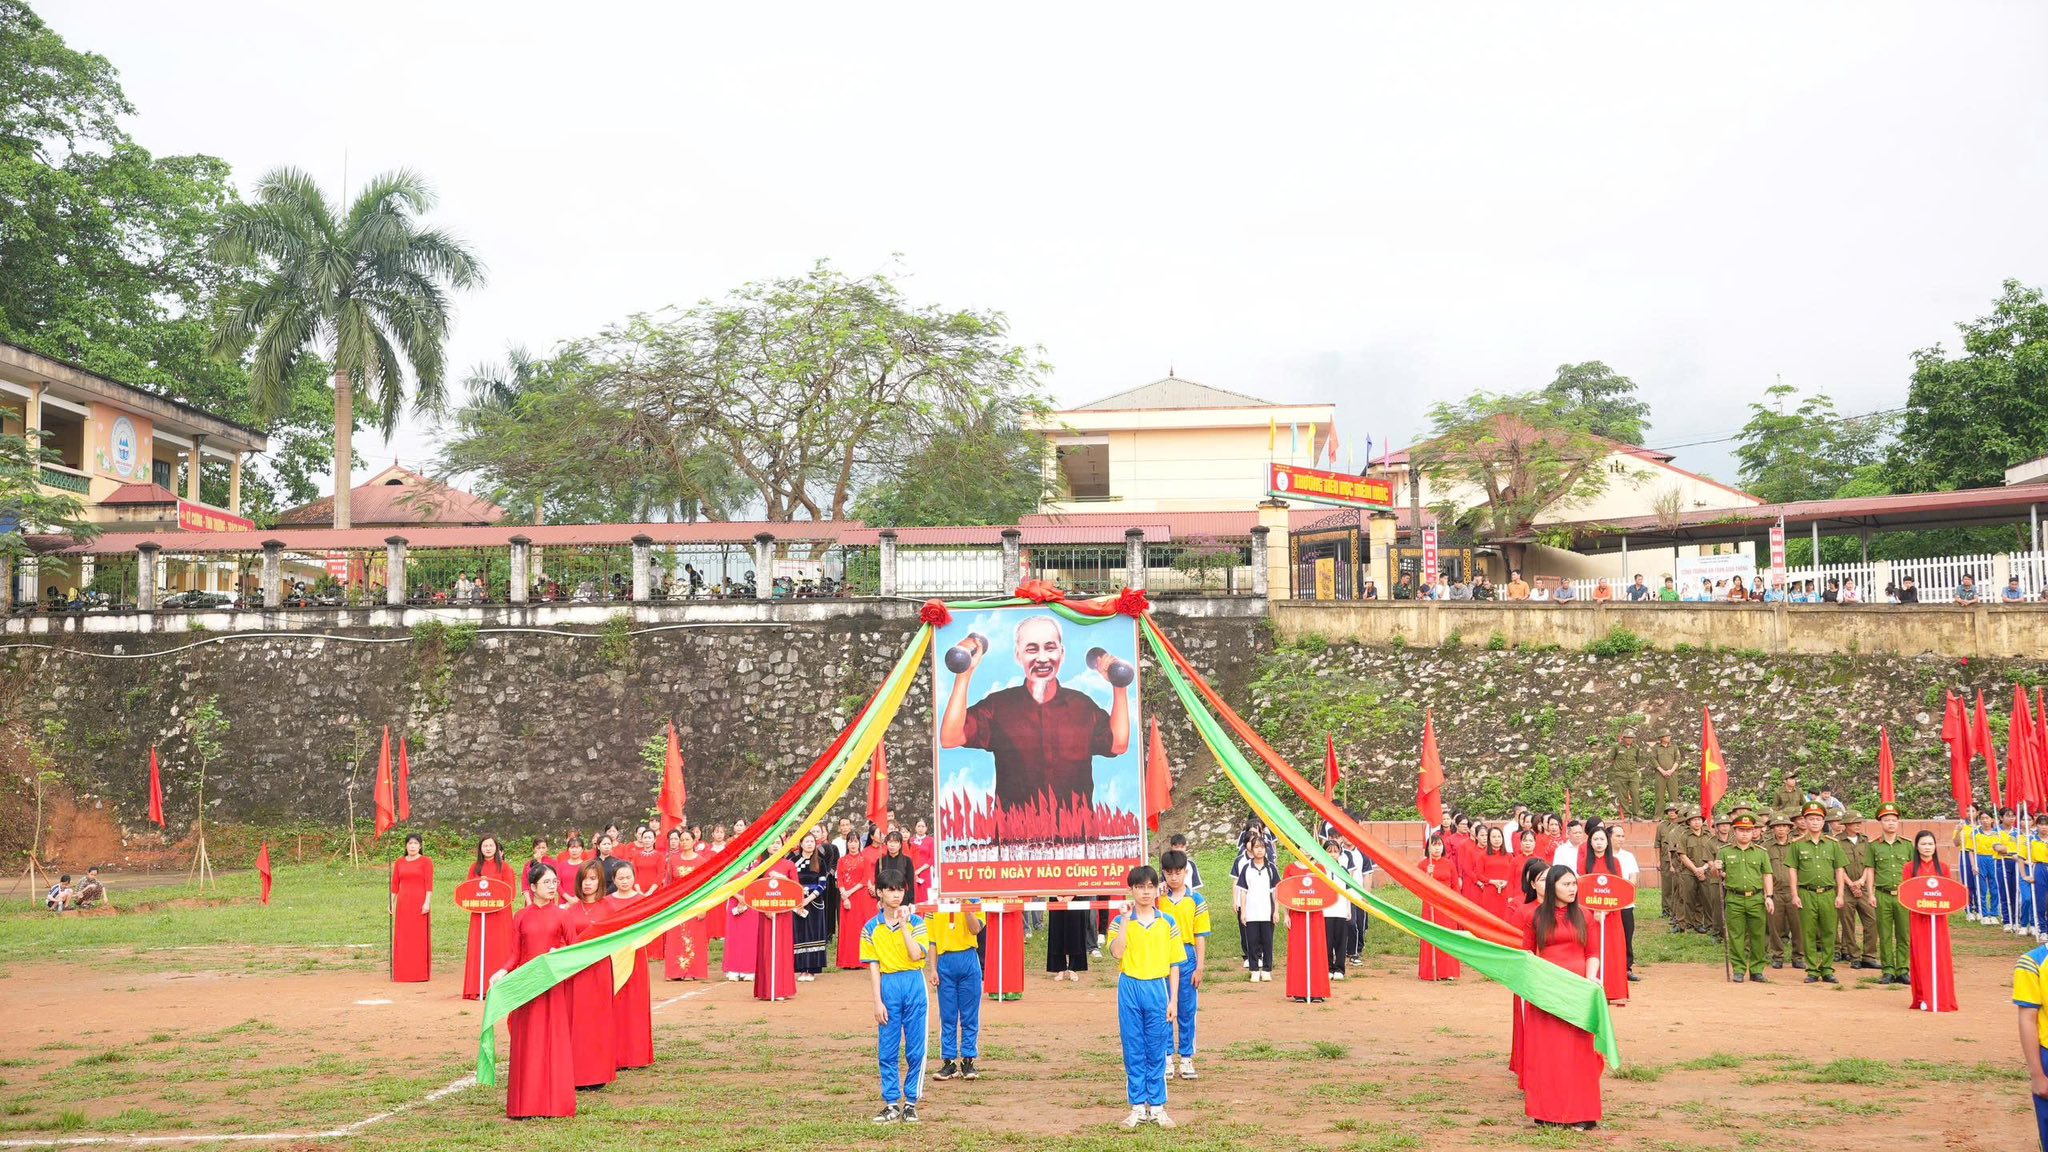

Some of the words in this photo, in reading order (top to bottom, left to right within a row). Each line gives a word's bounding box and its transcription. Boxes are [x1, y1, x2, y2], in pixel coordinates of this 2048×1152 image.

[957, 866, 974, 883] TỰ
[978, 866, 996, 880] TÔI
[1001, 865, 1033, 879] NGÀY
[1037, 863, 1061, 878] NÀO
[1066, 864, 1098, 878] CŨNG
[1102, 863, 1125, 879] TẬP
[1585, 895, 1602, 905] GIÁO
[1603, 897, 1618, 907] DỤC
[1916, 898, 1937, 908] CÔNG
[1938, 900, 1950, 909] AN
